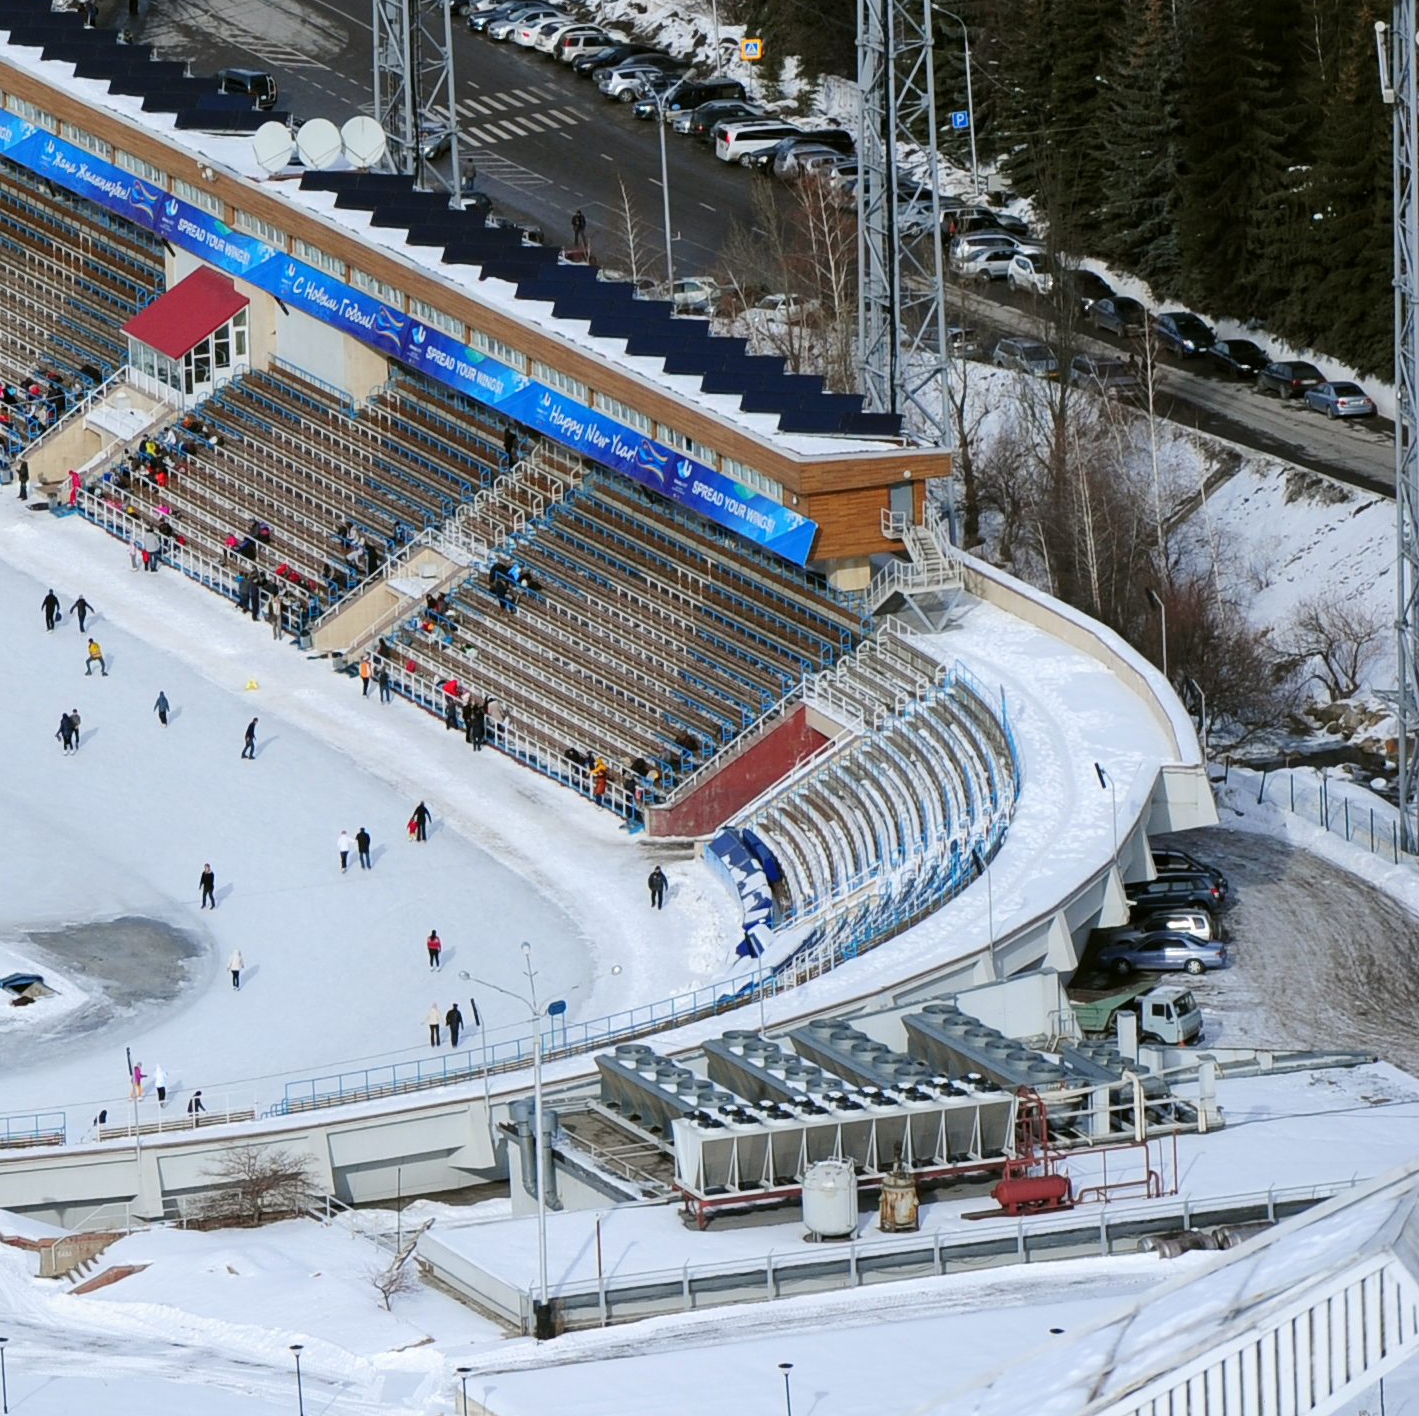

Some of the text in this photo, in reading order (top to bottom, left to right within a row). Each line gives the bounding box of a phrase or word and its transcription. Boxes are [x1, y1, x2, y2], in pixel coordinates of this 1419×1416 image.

[177, 218, 205, 241] SPREAD
[205, 232, 225, 252] YOUR
[304, 281, 339, 311] Новым
[339, 298, 376, 329] Годом!
[426, 345, 455, 371] SPREAD
[455, 360, 477, 382] YOUR
[549, 404, 584, 441] Happy
[585, 423, 610, 448] New
[611, 434, 638, 463] Year!
[692, 480, 723, 506] SPREAD
[724, 496, 746, 519] YOUR
[746, 507, 776, 533] WINGS!
